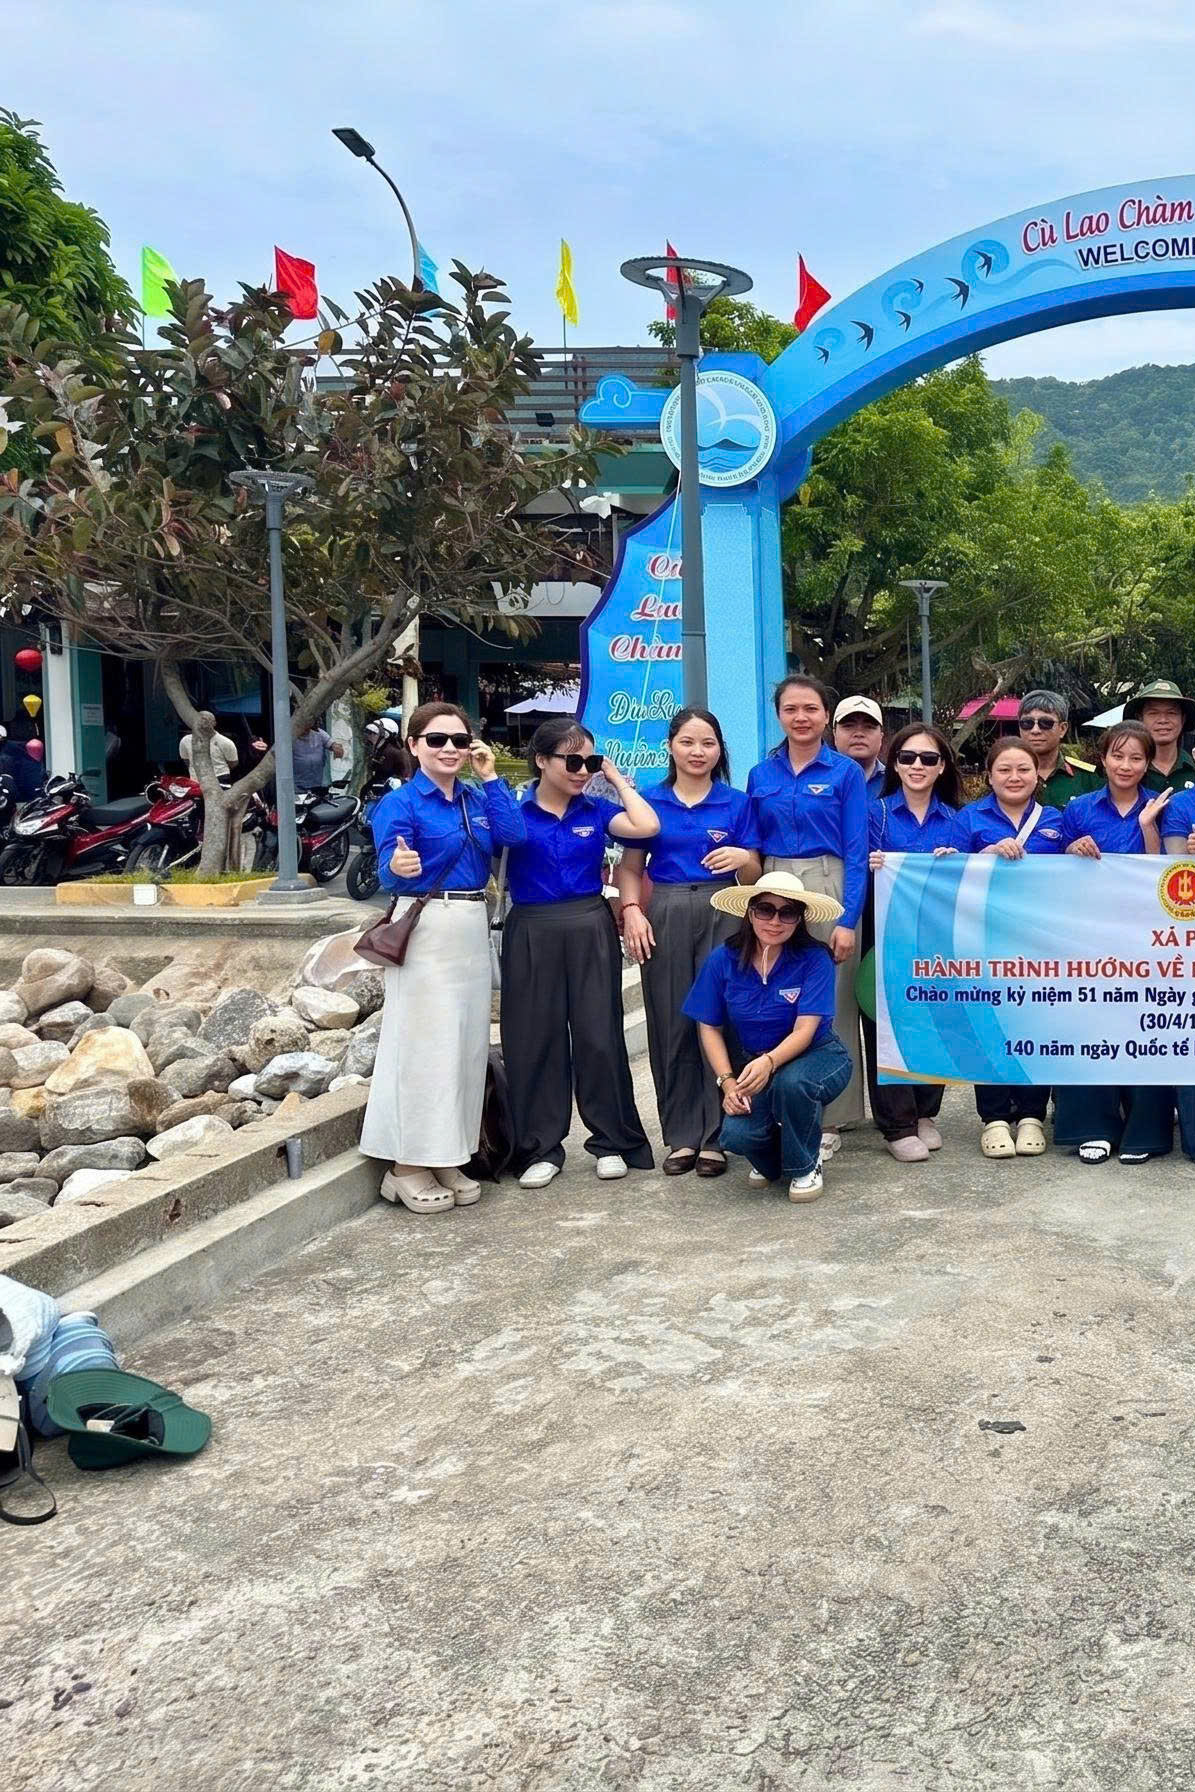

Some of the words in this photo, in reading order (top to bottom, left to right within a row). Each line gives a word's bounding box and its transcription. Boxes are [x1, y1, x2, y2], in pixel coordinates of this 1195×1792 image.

[1023, 218, 1058, 253] Cù
[1065, 211, 1109, 241] Lao
[1119, 195, 1194, 229] Chàm
[914, 956, 981, 977] HÀNH
[988, 956, 1060, 978] TRÌNH
[1067, 957, 1150, 978] HƯỚNG
[1157, 954, 1184, 978] VỀ
[905, 985, 948, 1002] Chào
[1007, 985, 1026, 1006] kỷ
[1032, 986, 1072, 1006] niệm
[1078, 987, 1096, 1003] 51
[1103, 987, 1139, 1003] năm
[1145, 986, 1187, 1007] Ngày
[1005, 1040, 1034, 1056] 140
[1080, 1040, 1120, 1059] ngày
[1125, 1038, 1168, 1059] Quốc
[1172, 1038, 1190, 1056] tế
